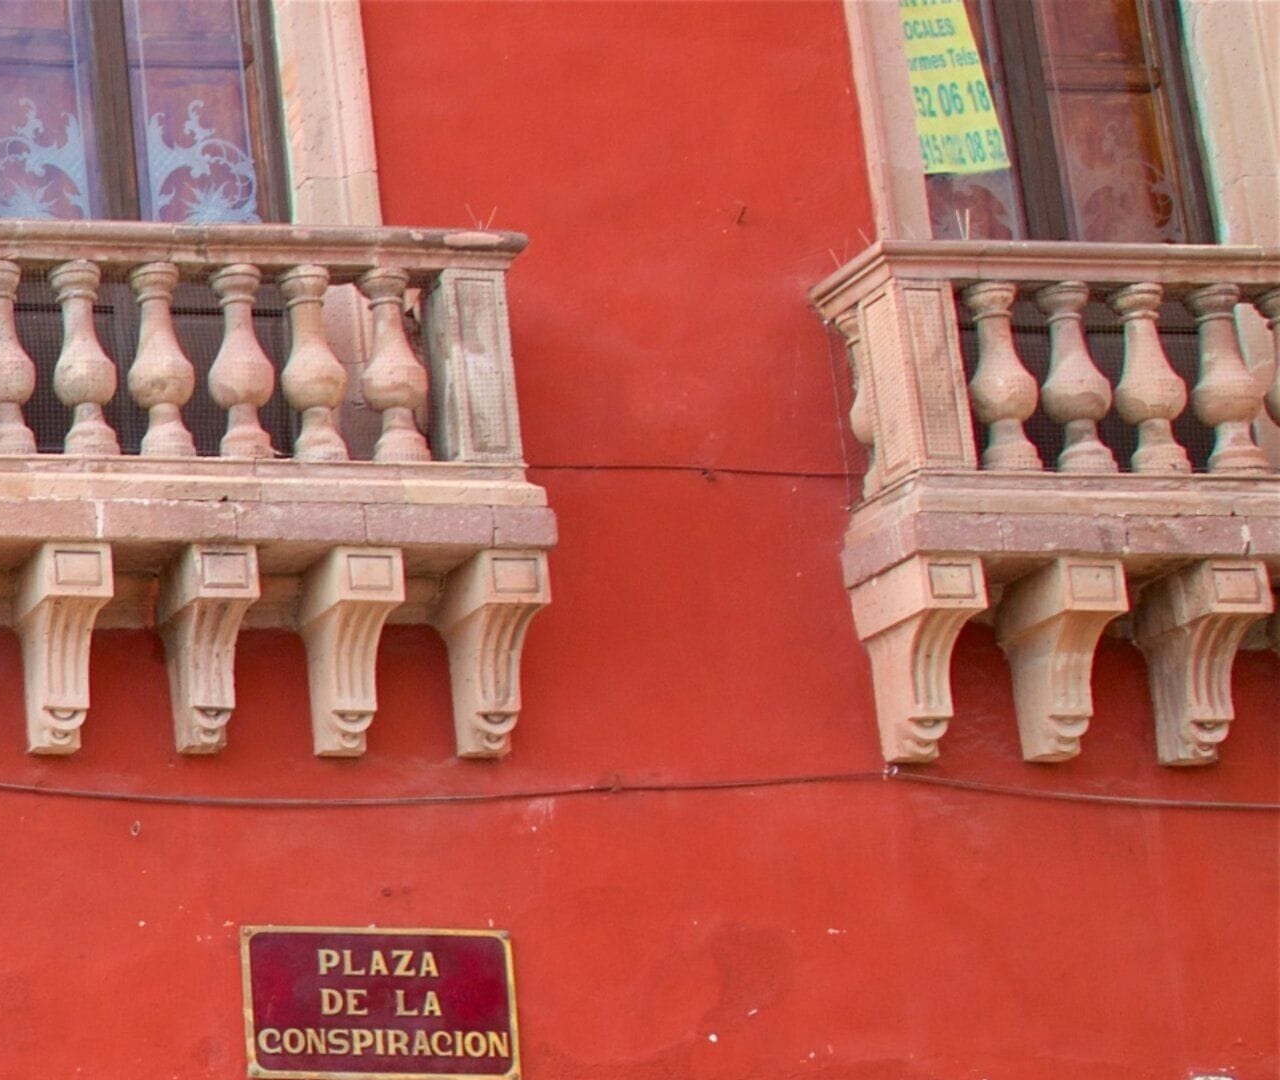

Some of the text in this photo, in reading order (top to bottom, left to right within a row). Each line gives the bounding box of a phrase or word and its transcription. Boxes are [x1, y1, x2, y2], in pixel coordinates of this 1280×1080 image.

[937, 82, 965, 116] 06
[966, 79, 991, 113] 18
[317, 948, 440, 977] PLAZA
[320, 988, 443, 1016] DE LA
[257, 1028, 510, 1058] CONSPIRACION
